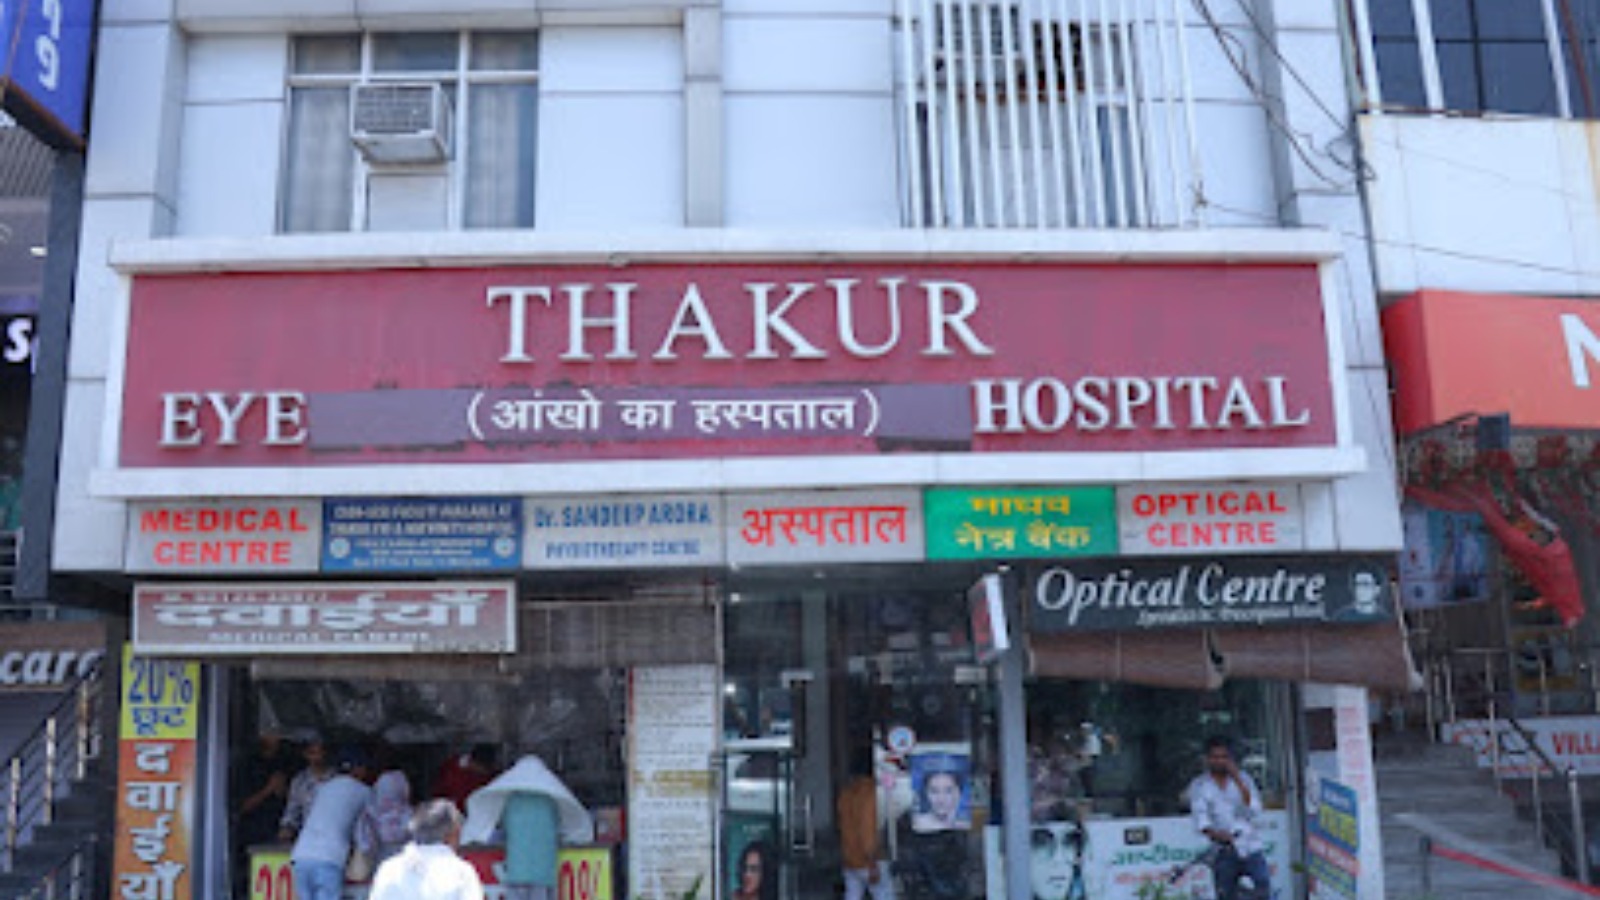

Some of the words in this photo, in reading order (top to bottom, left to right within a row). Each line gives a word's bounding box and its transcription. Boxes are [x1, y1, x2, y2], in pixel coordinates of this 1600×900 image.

[486, 276, 993, 364] THAKUR
[159, 391, 308, 447] EYE
[617, 400, 677, 430] का
[691, 388, 880, 437] हस्पताल)
[972, 377, 1309, 434] HOSPITAL
[141, 507, 308, 533] MEDICAL
[562, 503, 646, 527] SANDEEP
[649, 502, 711, 524] ARORA
[1132, 491, 1288, 517] OPTICAL
[740, 505, 908, 547] अस्पताल
[1147, 521, 1276, 546] CENTRE
[154, 540, 292, 566] CENTRE
[1036, 566, 1190, 624] Optical
[1199, 563, 1326, 604] Centre
[129, 658, 194, 703] 20%
